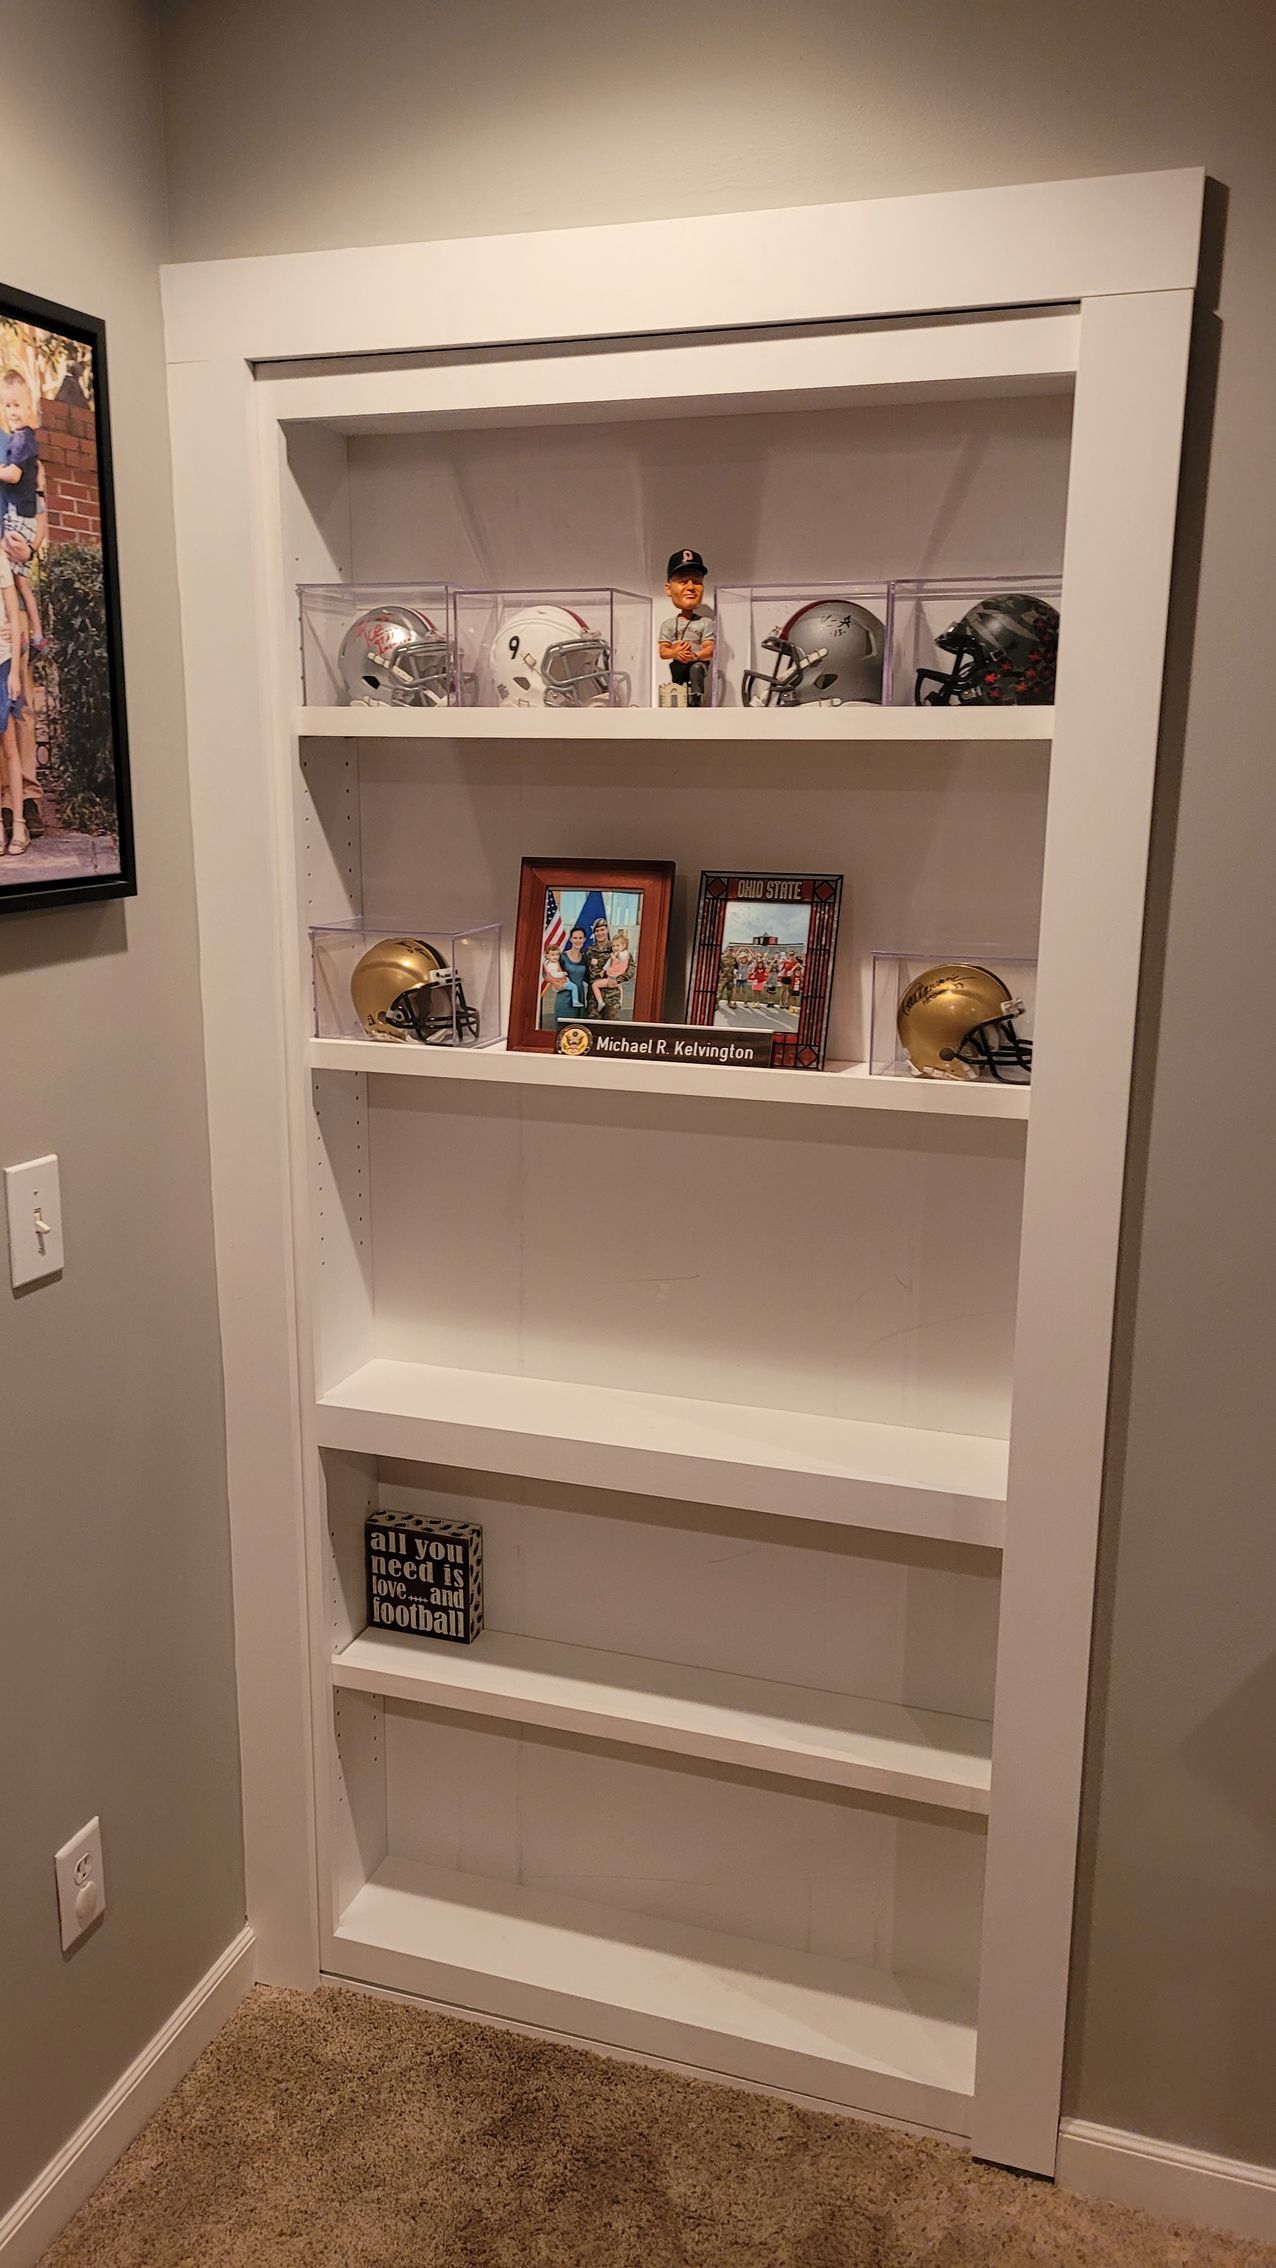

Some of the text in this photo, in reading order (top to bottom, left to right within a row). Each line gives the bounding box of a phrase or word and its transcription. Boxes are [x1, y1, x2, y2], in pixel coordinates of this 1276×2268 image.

[508, 635, 520, 660] 9
[737, 879, 803, 900] OHIO STATE
[596, 1036, 754, 1062] Michael R. Kelvington
[370, 1531, 464, 1564] all you
[371, 1555, 464, 1588] need is
[430, 1587, 465, 1609] and
[372, 1596, 465, 1638] football
